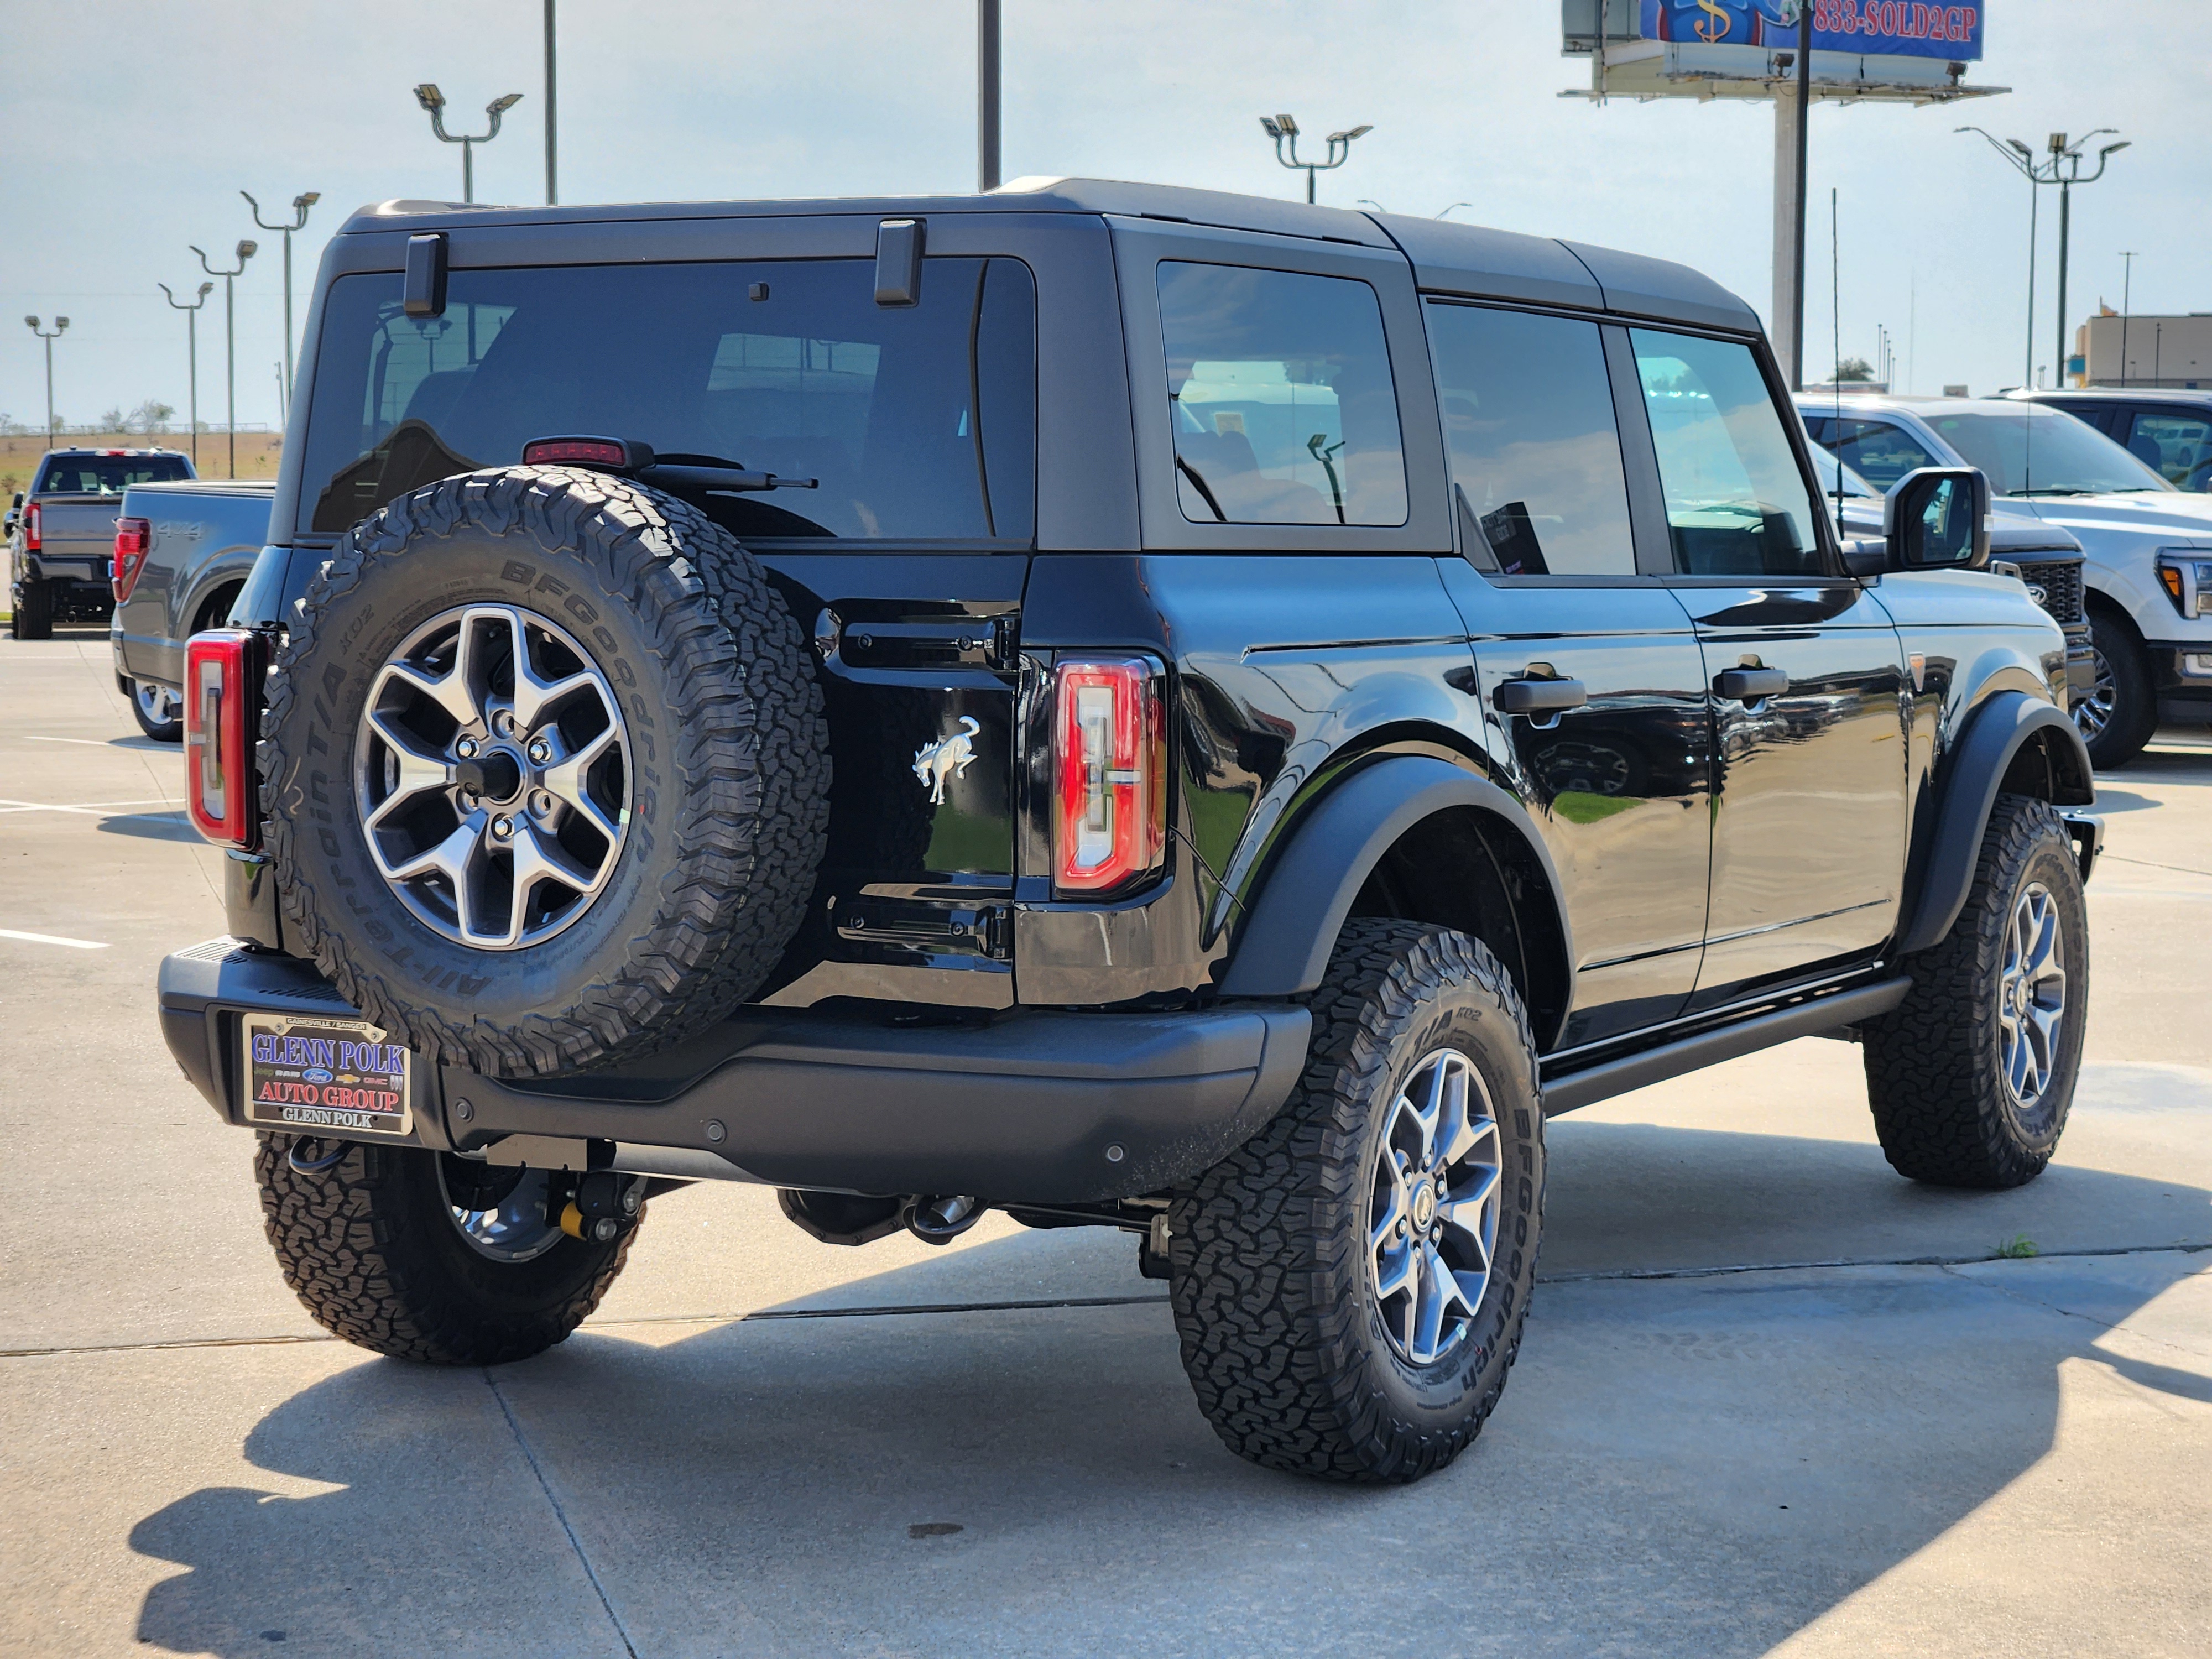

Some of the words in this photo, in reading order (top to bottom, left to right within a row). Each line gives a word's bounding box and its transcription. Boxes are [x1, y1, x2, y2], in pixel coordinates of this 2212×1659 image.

[1814, 0, 1976, 42] 833-SOLD2GP
[501, 559, 661, 866] BFGoodrich
[307, 770, 494, 998] All-Terrain
[287, 1018, 331, 1027] GAINESVILLE
[252, 1034, 336, 1068] GLENN
[339, 1041, 405, 1074] POLK
[259, 1081, 319, 1104] AUTO
[322, 1086, 399, 1112] GROUP
[282, 1108, 332, 1123] GLENN
[333, 1112, 373, 1129] POLK
[1461, 1108, 1532, 1391] BFGoodrich
